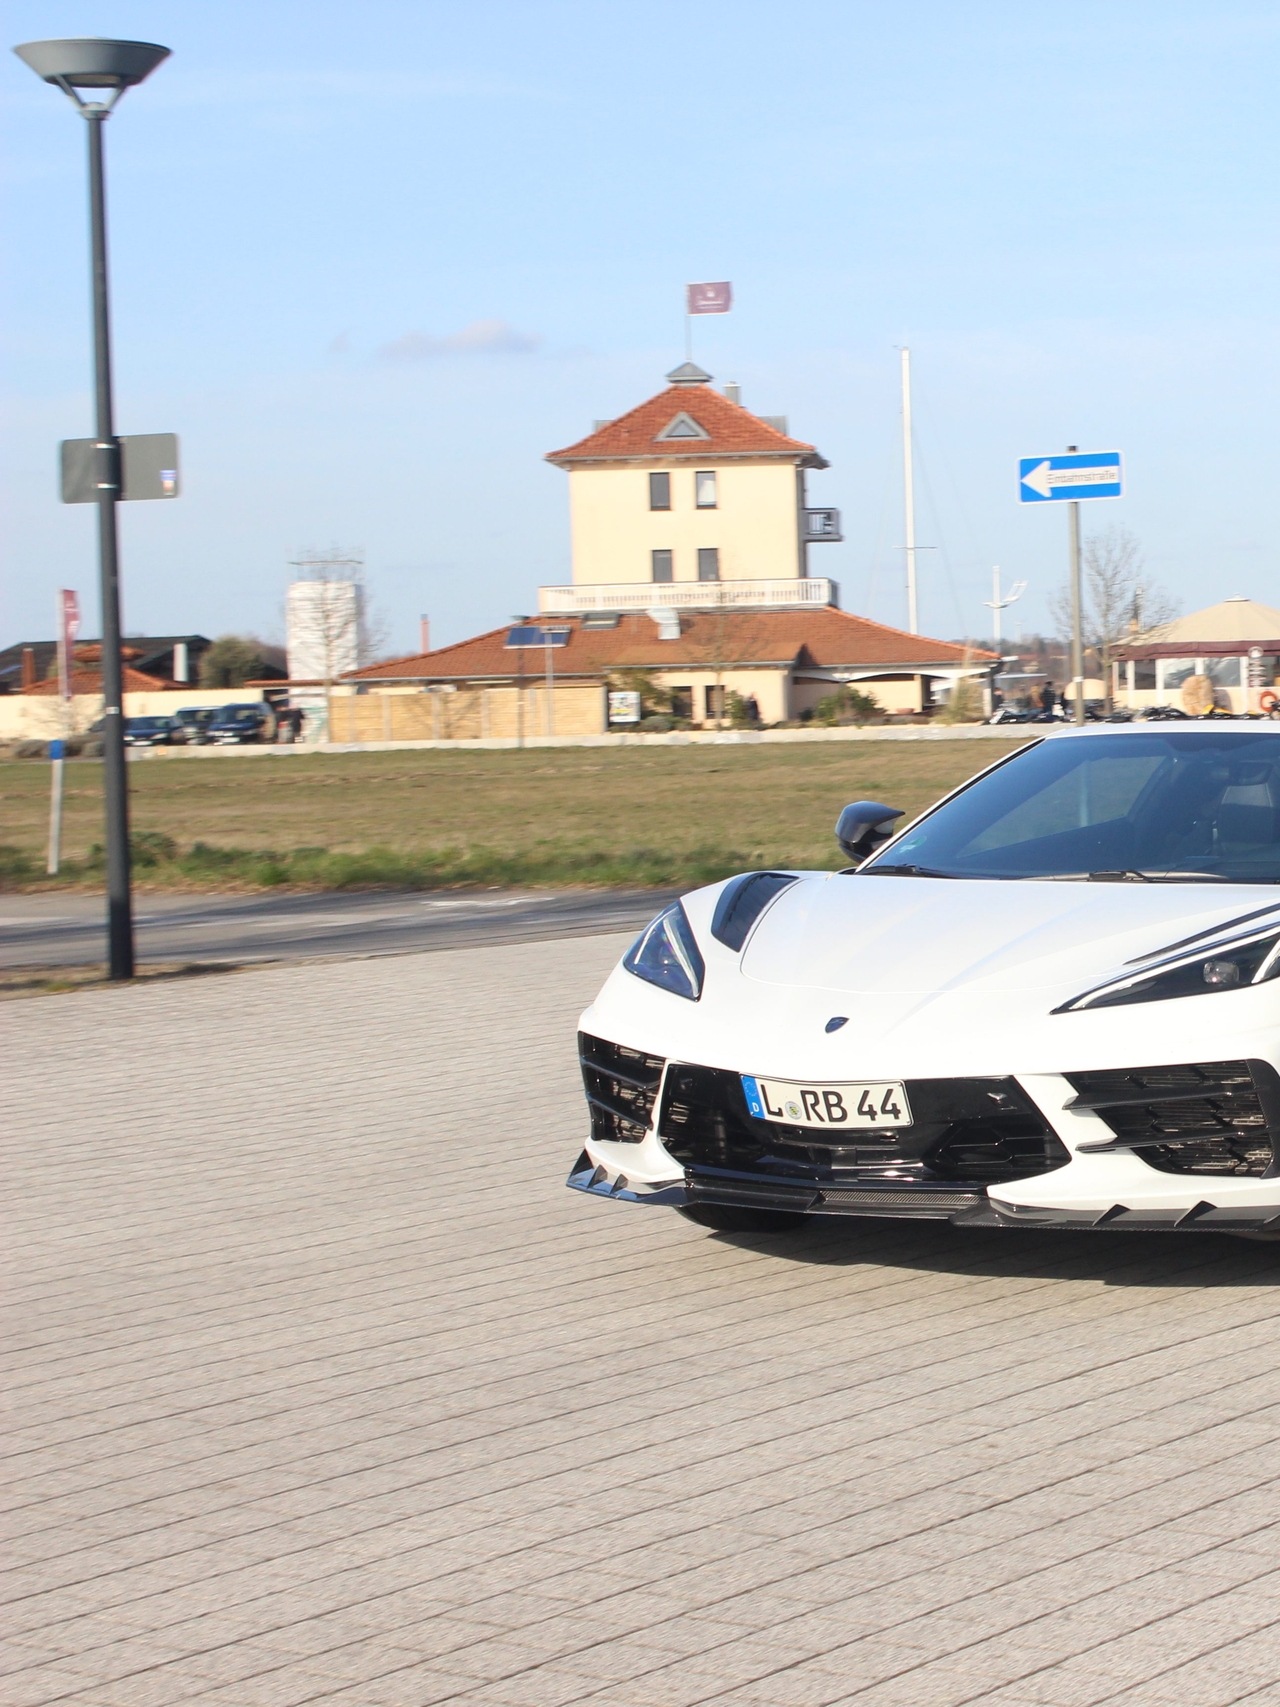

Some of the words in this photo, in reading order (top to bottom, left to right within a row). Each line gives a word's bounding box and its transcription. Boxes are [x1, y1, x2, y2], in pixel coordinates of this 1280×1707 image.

[752, 1102, 760, 1112] D
[760, 1084, 783, 1117] L
[800, 1090, 847, 1122] RB
[857, 1089, 901, 1121] 44
